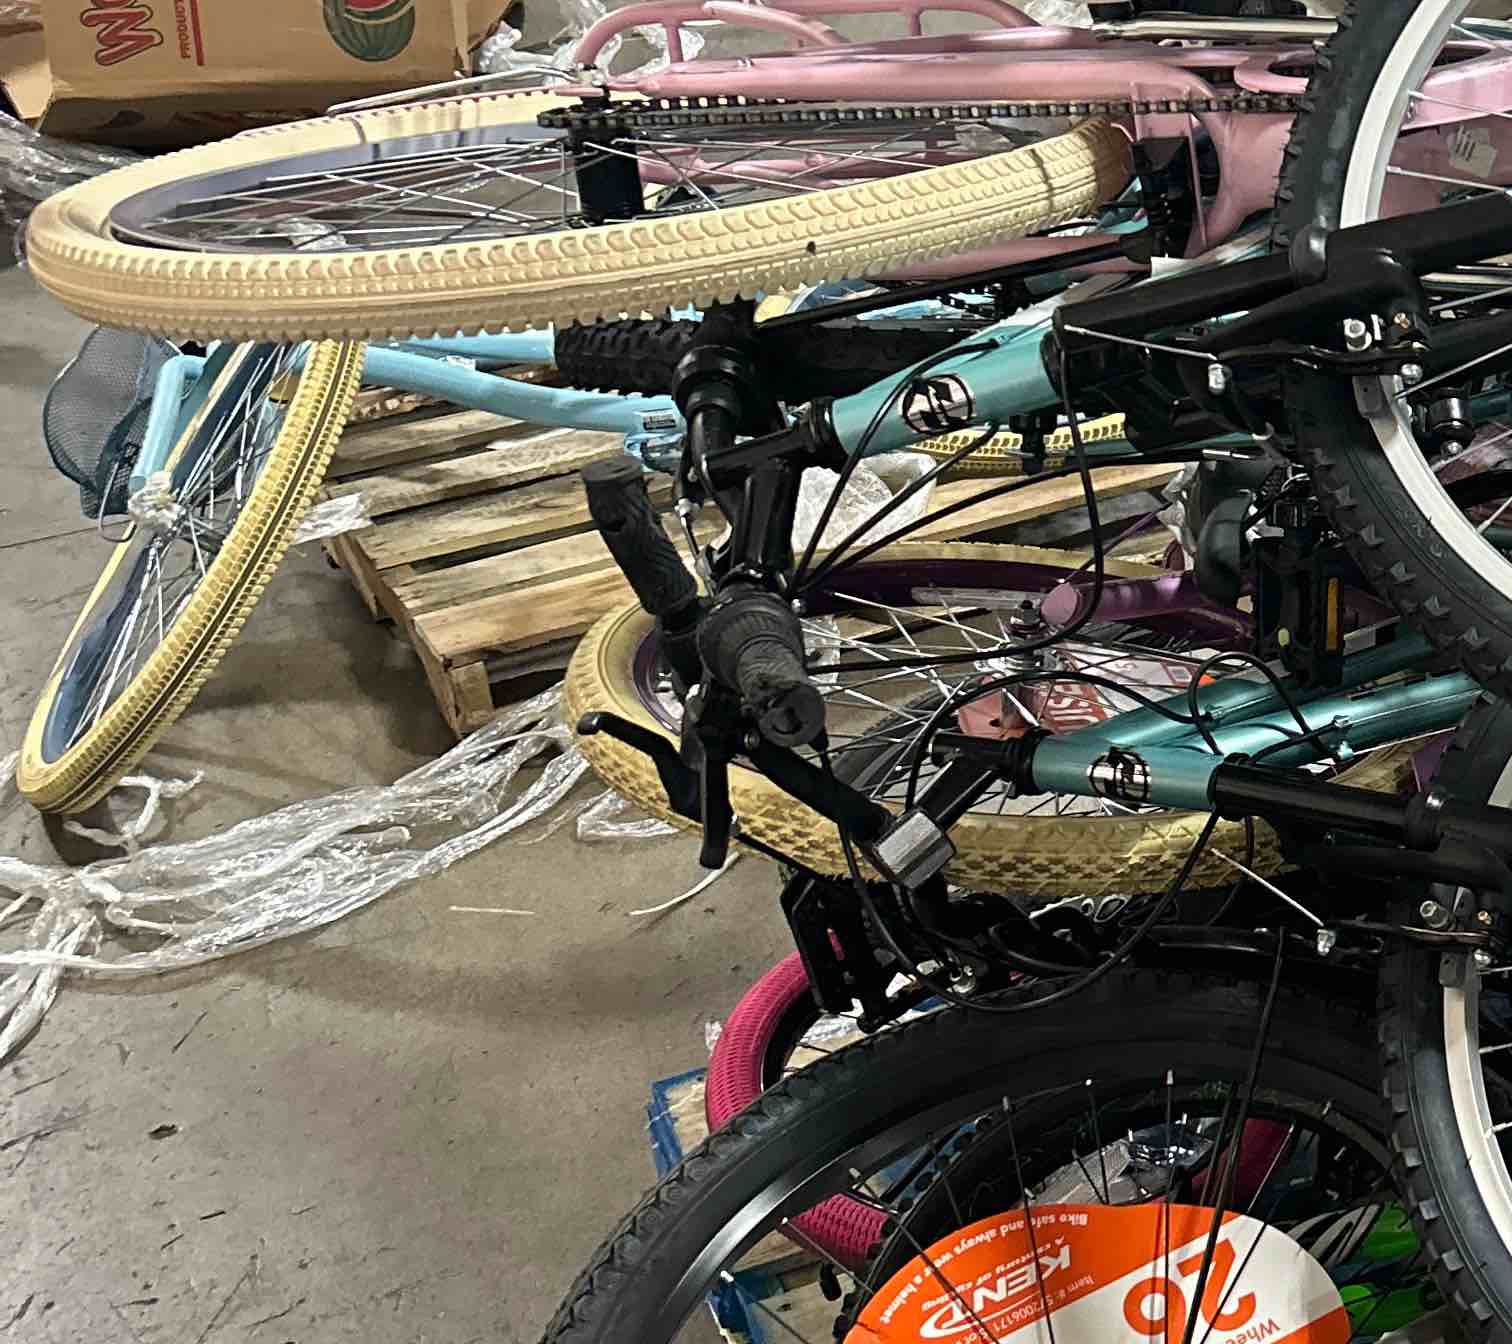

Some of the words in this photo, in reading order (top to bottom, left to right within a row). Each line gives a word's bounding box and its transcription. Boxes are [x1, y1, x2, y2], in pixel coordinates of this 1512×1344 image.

[1000, 1220, 1025, 1238] and
[1059, 1213, 1089, 1226] Bike
[954, 1230, 999, 1255] always
[932, 1244, 1071, 1335] KENT
[880, 1283, 918, 1325] helmet
